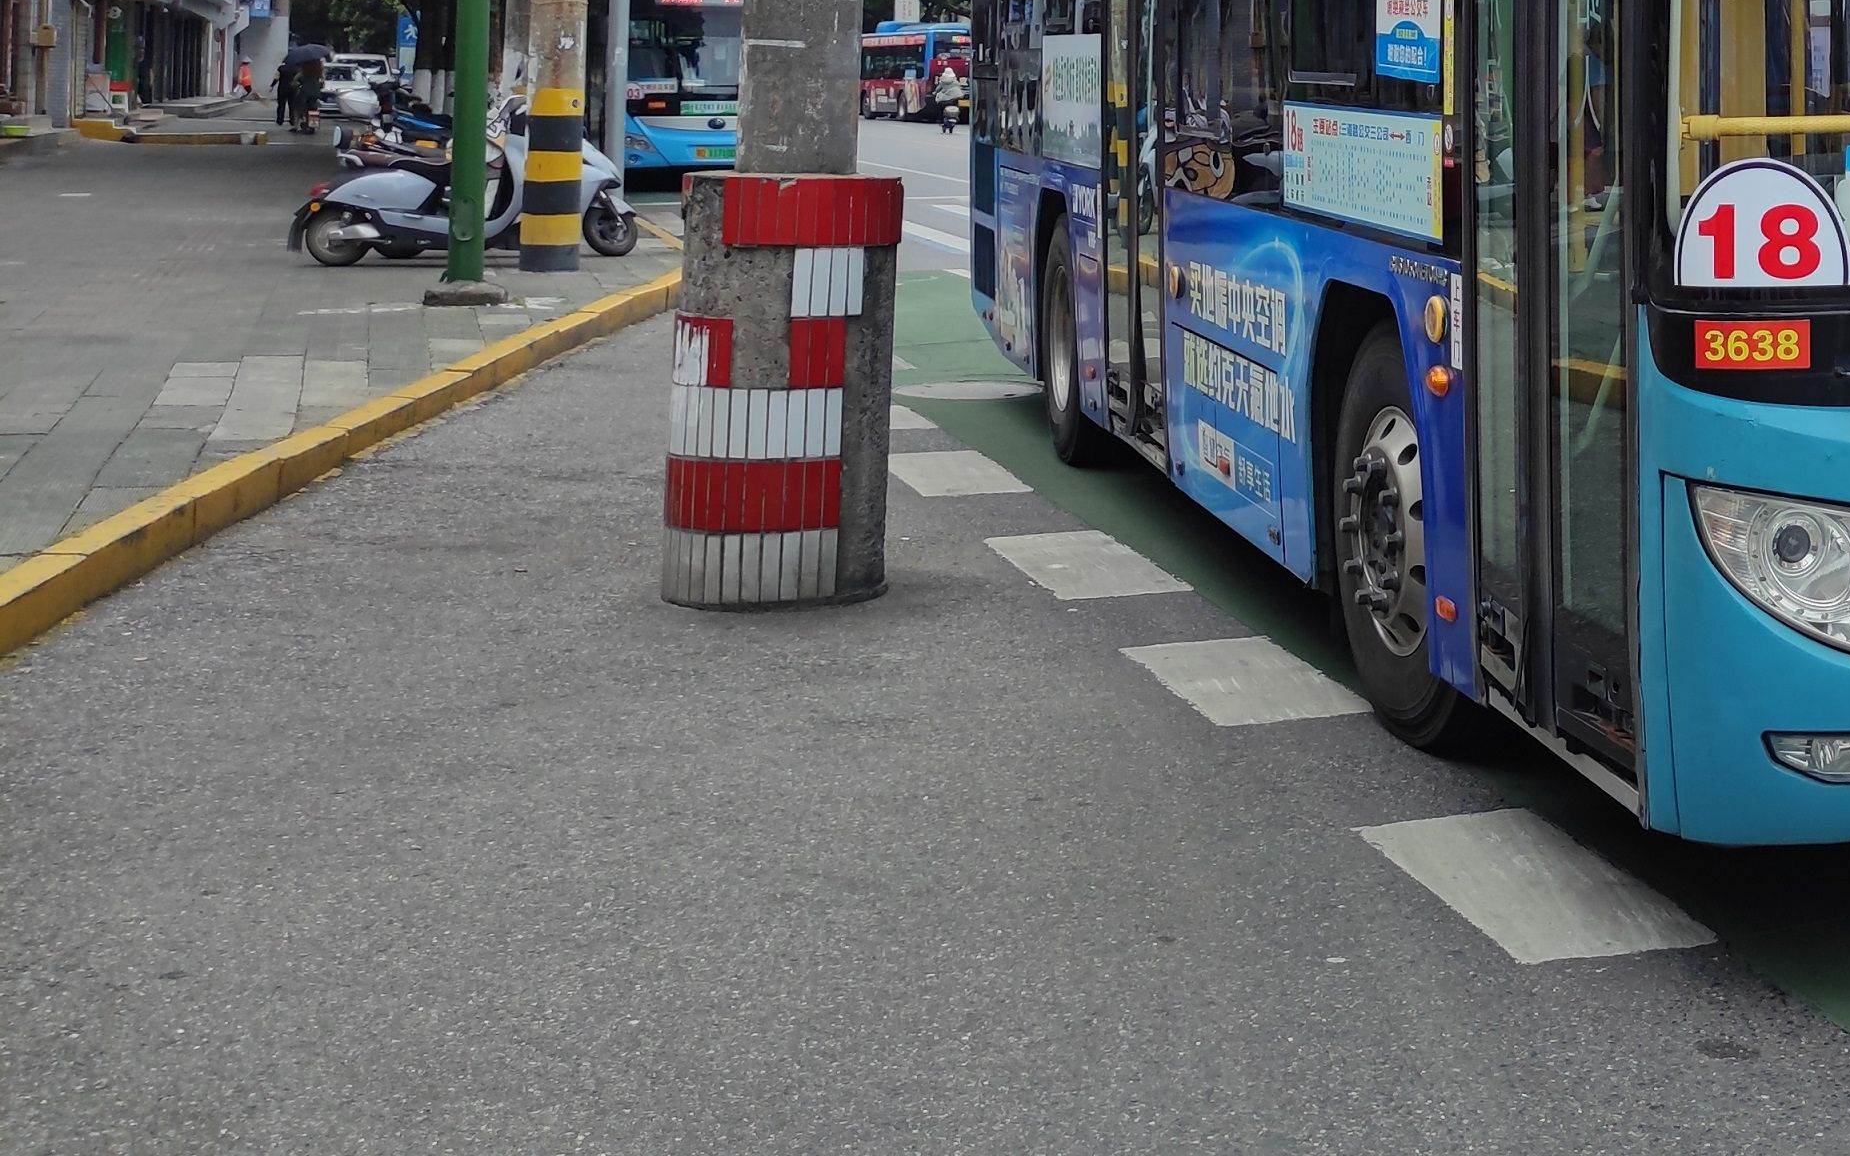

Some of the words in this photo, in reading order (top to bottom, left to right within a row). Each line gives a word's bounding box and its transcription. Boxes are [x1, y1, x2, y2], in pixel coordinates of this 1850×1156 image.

[1697, 203, 1823, 280] 18
[1188, 260, 1287, 358] 买地暖中央空调
[1704, 329, 1801, 362] 3638
